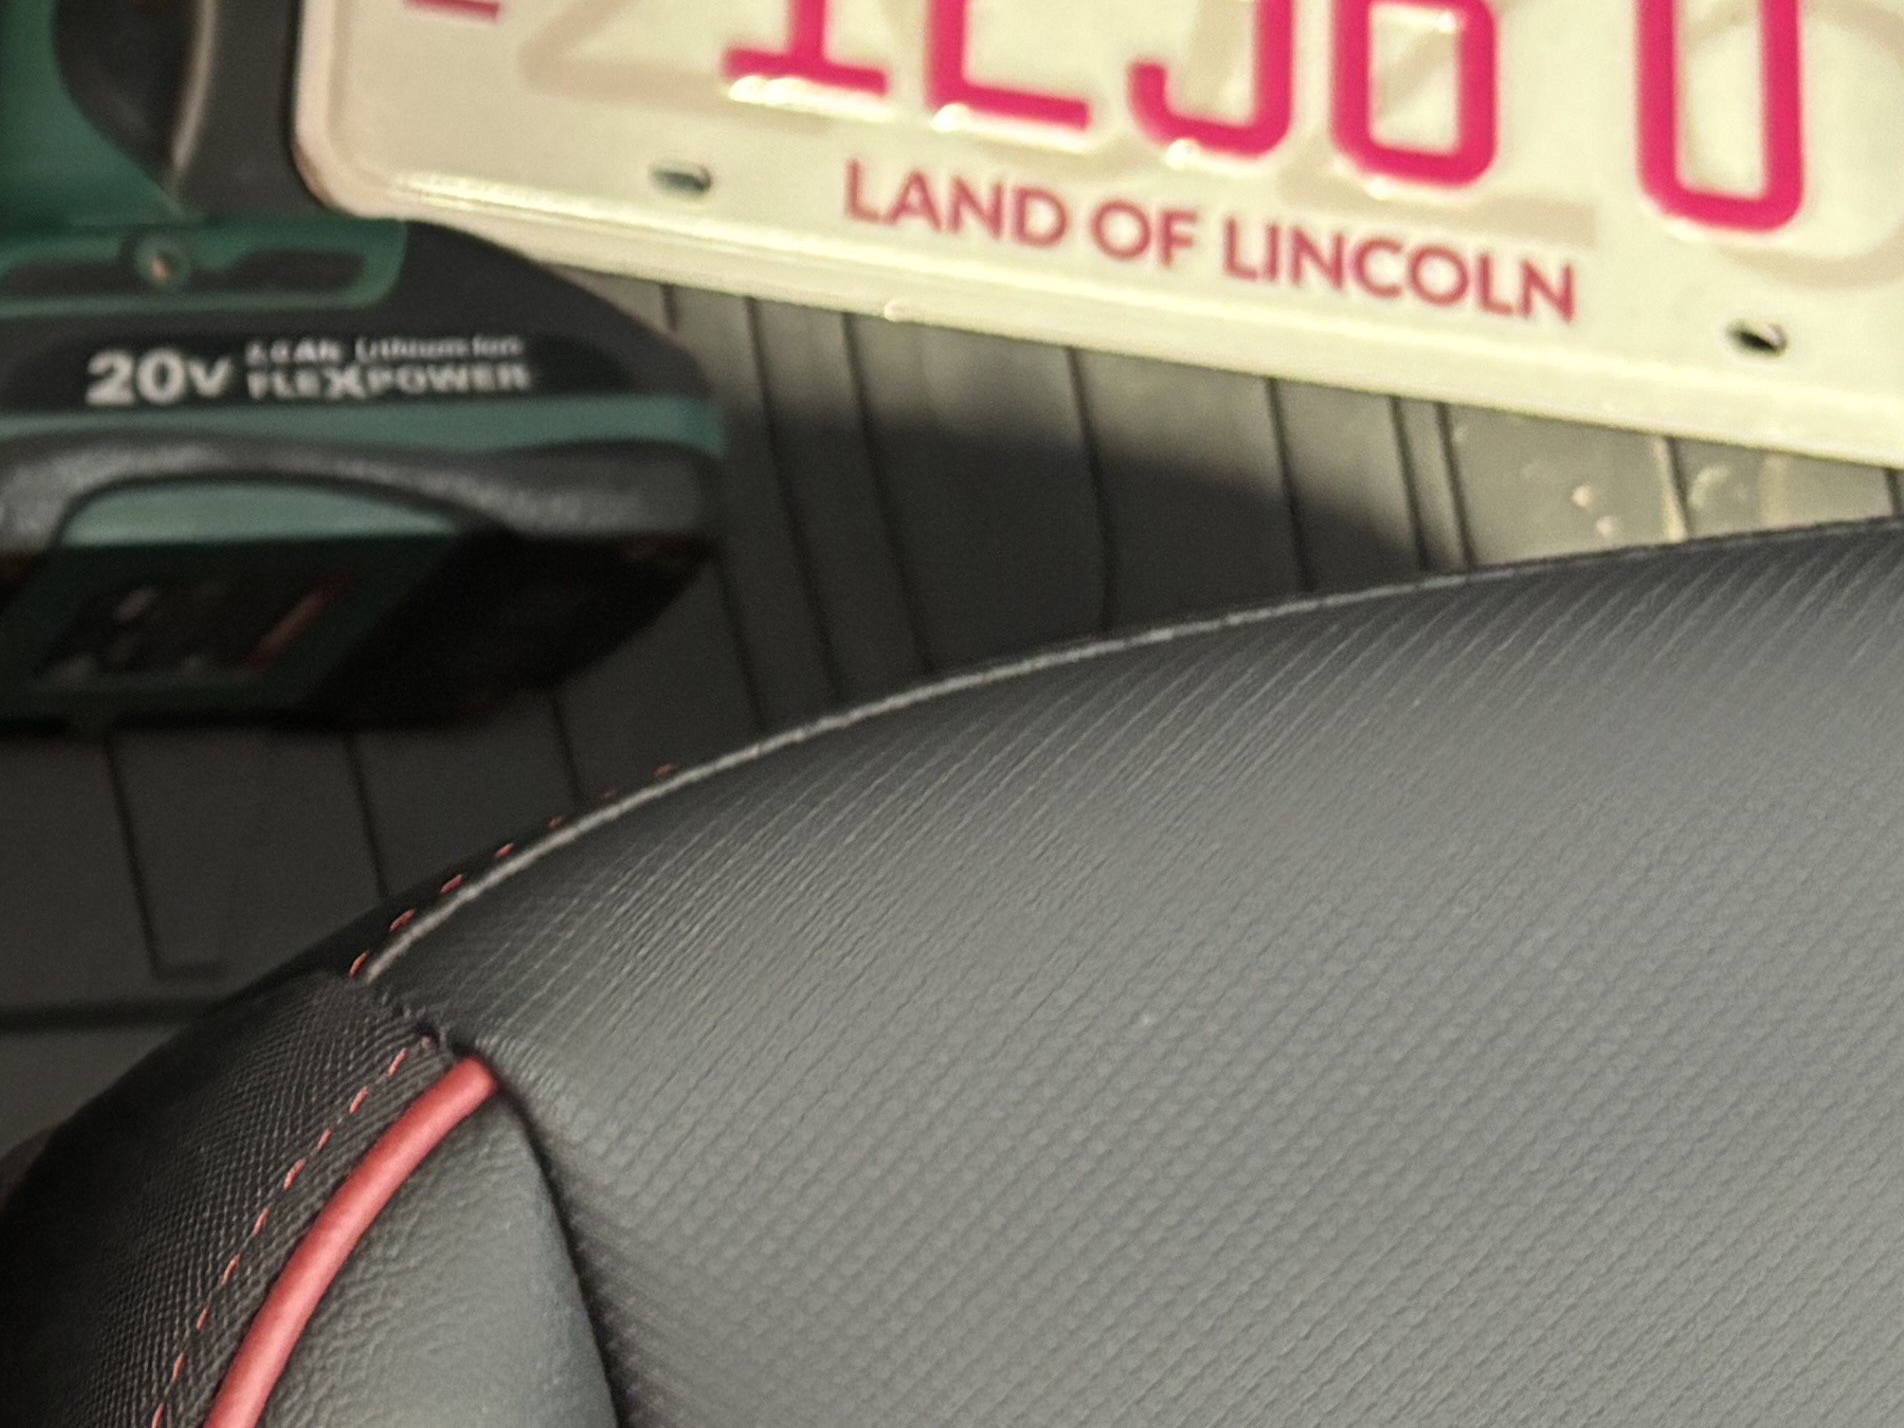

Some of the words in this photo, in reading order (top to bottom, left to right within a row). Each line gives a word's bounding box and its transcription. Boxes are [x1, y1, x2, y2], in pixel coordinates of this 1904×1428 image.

[845, 159, 1073, 249] LAND
[1087, 198, 1199, 267] OF
[1222, 217, 1578, 324] LINCOLN
